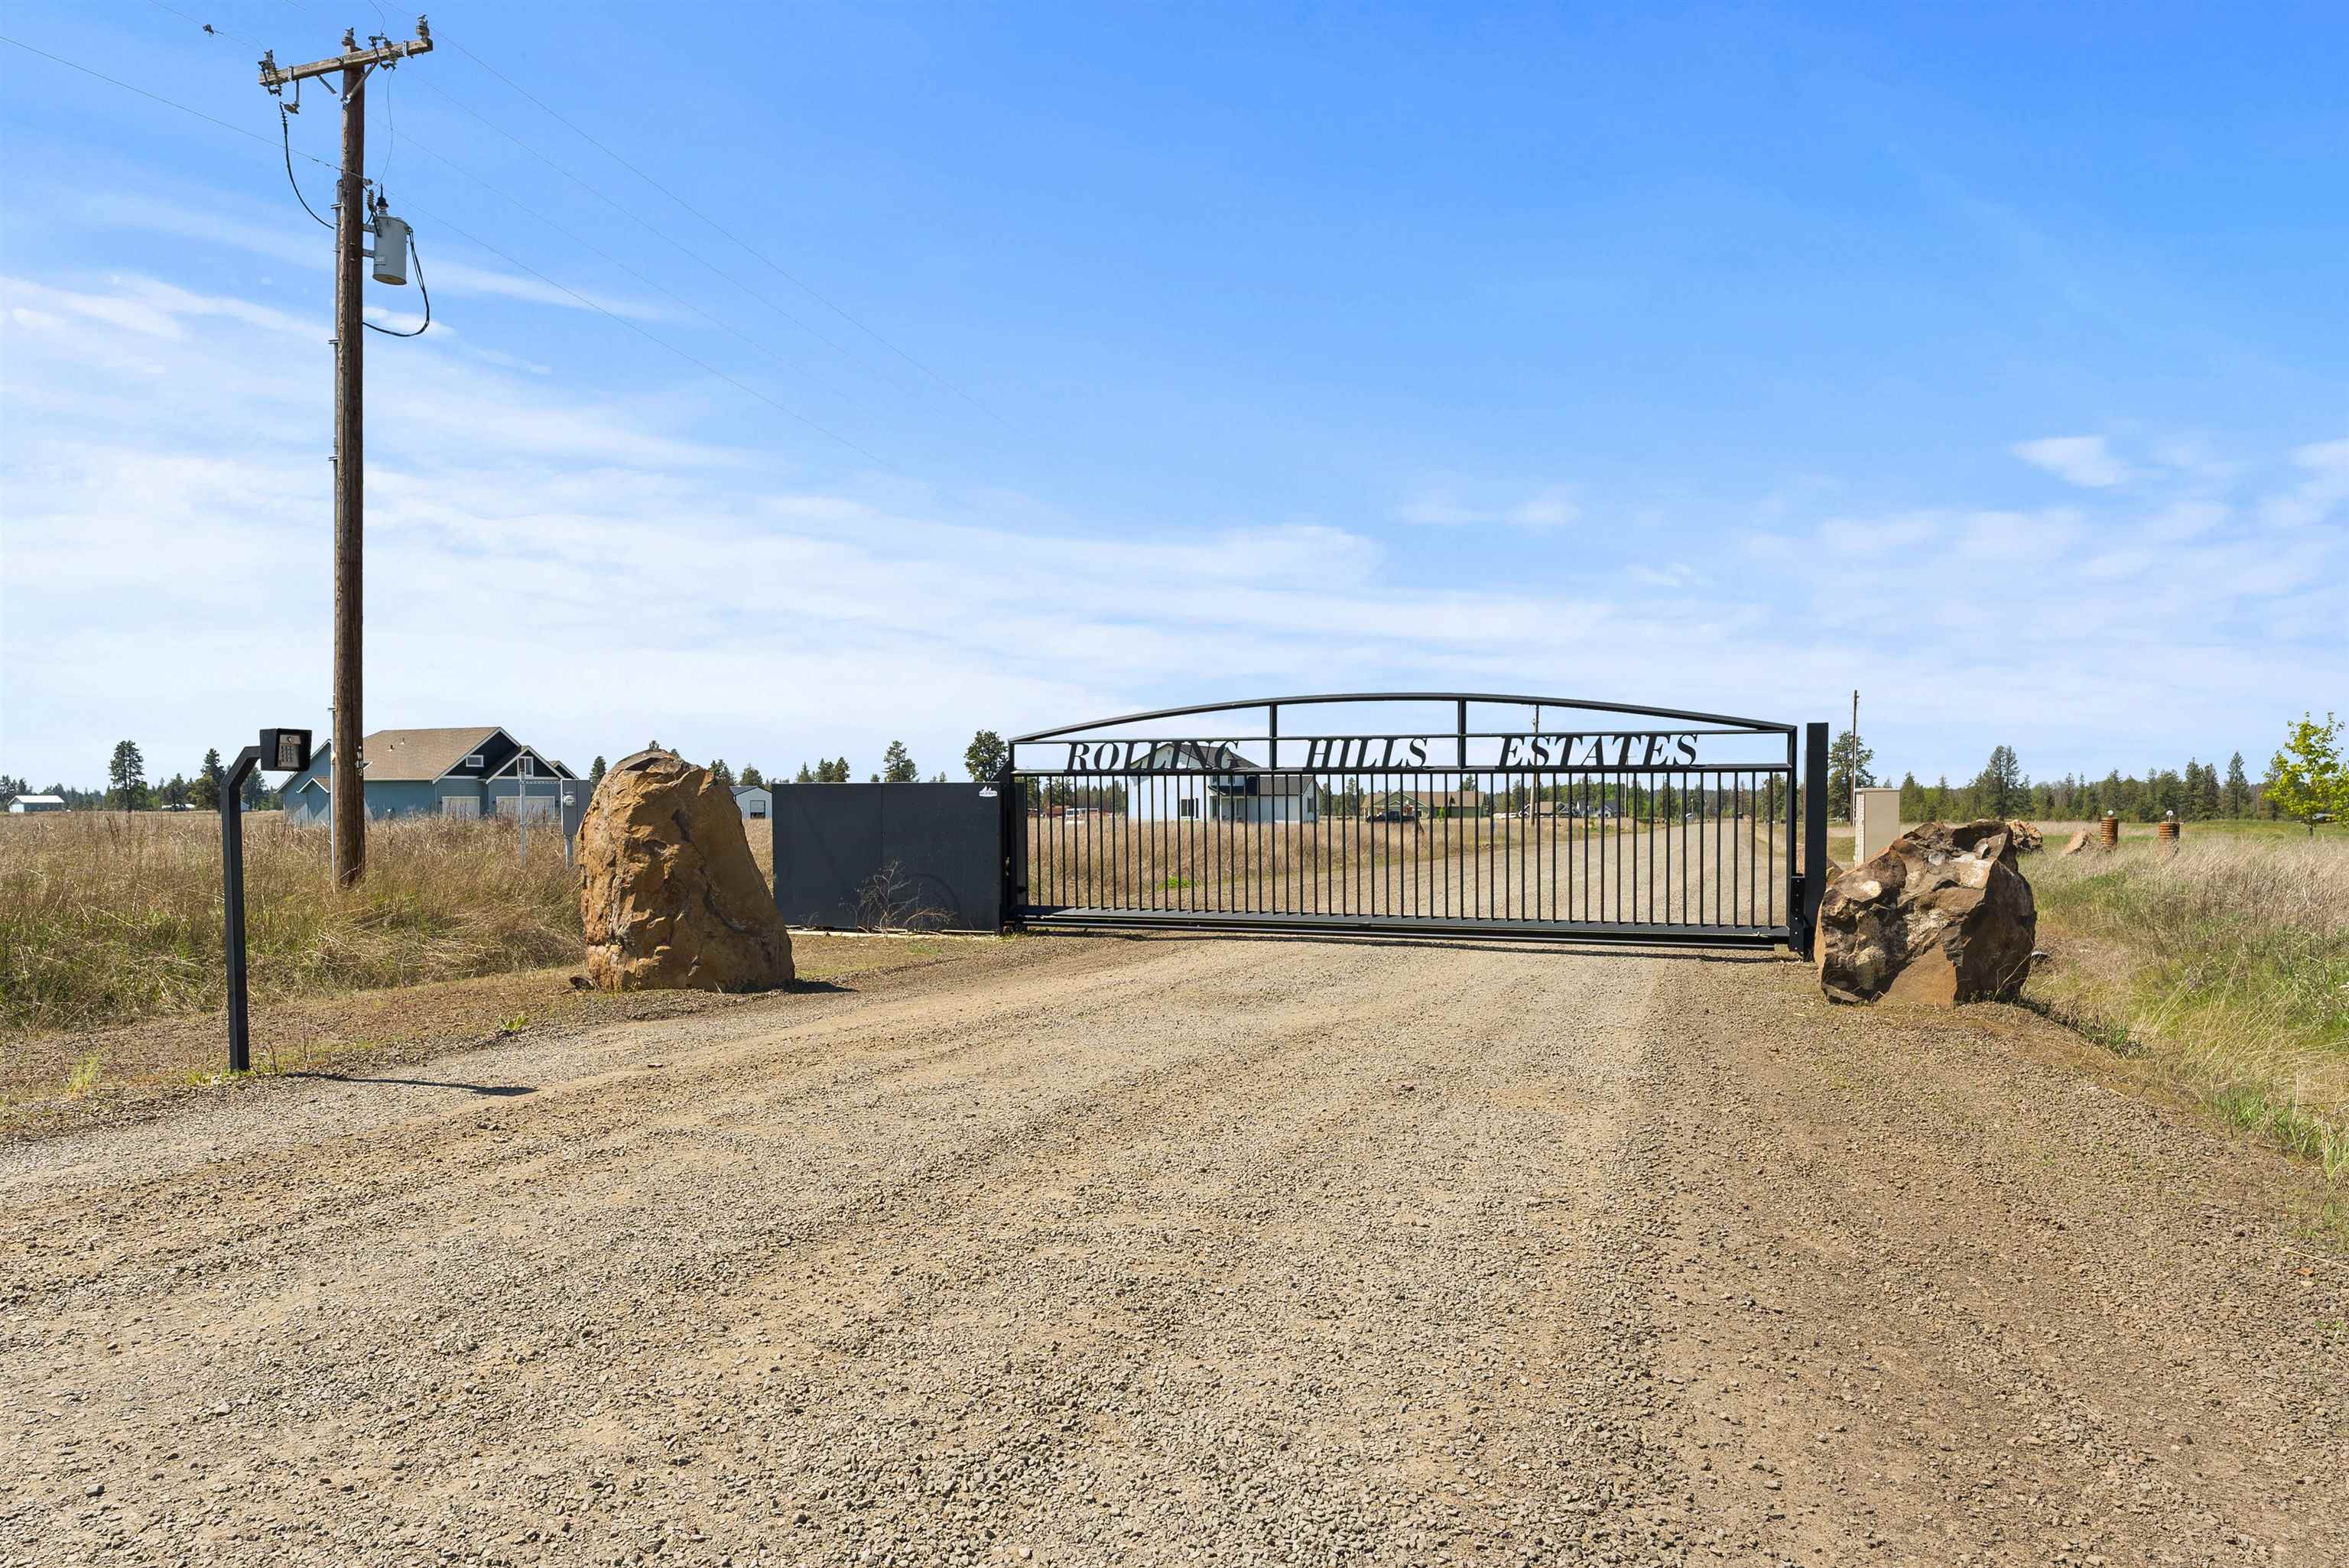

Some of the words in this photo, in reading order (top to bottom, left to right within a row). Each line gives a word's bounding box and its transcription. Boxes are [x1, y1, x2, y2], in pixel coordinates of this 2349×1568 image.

[1064, 740, 1240, 771] ROLLING
[1304, 737, 1429, 769] HILLS
[1499, 733, 1698, 767] ESTATES
